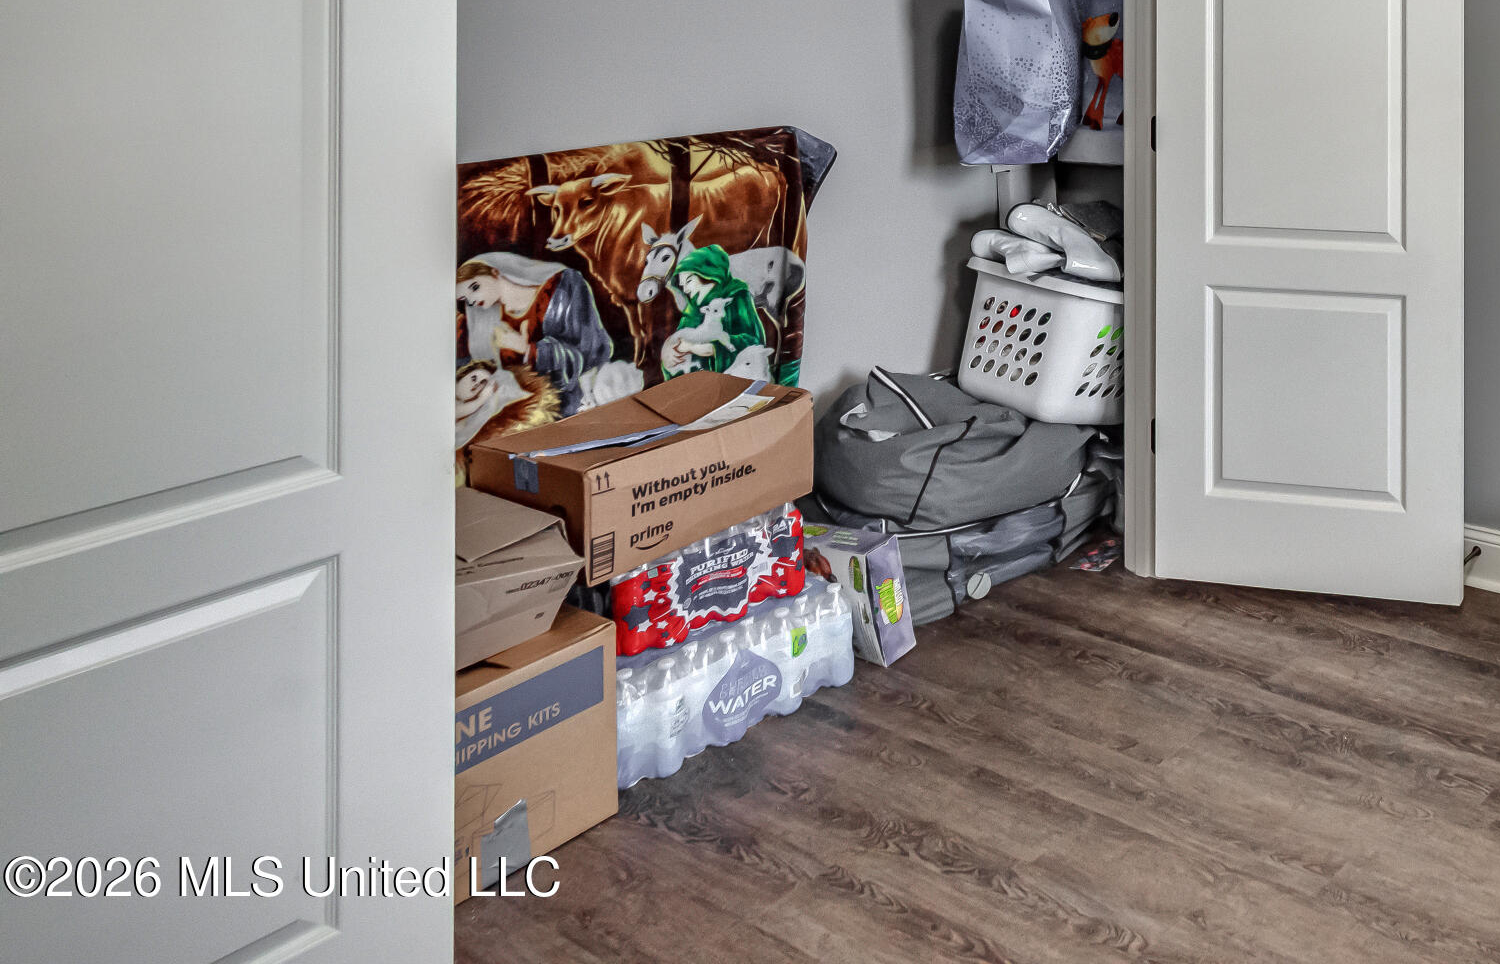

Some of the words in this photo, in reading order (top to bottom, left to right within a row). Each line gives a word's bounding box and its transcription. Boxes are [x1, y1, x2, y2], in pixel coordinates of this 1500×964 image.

[631, 500, 655, 517] I'm
[659, 481, 708, 507] empty
[711, 464, 756, 489] inside.
[632, 468, 697, 500] Without
[700, 460, 730, 480] you,
[630, 520, 674, 547] prime
[690, 548, 749, 576] PURIFIED
[708, 674, 778, 715] WATER
[528, 702, 561, 730] KITS
